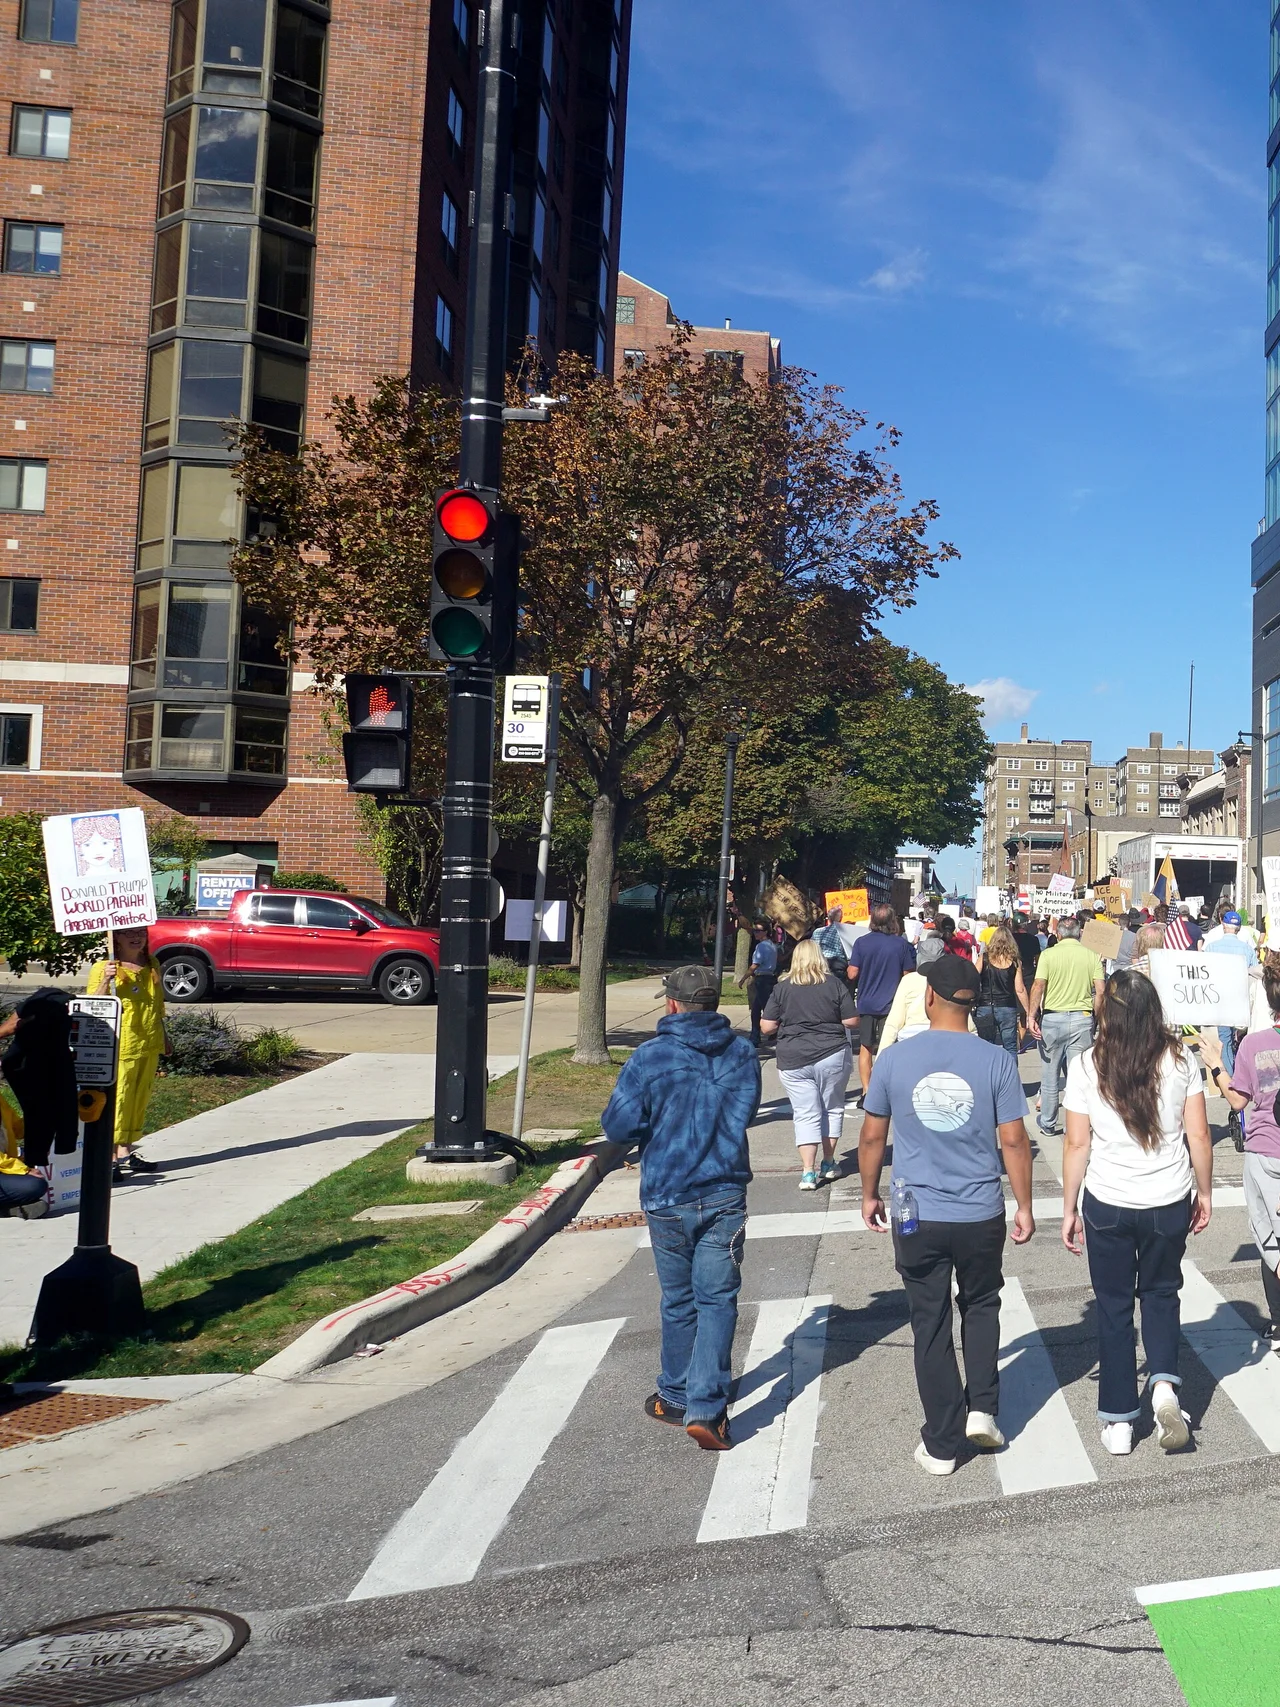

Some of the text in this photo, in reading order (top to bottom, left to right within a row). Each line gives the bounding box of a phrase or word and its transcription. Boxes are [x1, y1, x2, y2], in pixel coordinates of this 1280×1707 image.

[507, 723, 525, 733] 30
[1266, 860, 1280, 871] NO
[201, 877, 250, 888] RENTAL
[61, 879, 148, 901] DONALD TRUMP
[203, 888, 236, 898] OFFI
[1046, 890, 1073, 898] Military
[1095, 886, 1111, 895] ICE
[1043, 897, 1073, 905] American
[1109, 896, 1120, 904] OF
[64, 899, 105, 914] WORLD
[1037, 906, 1068, 914] Streets
[853, 907, 867, 918] CON
[1176, 964, 1210, 980] THIS
[1173, 983, 1221, 1005] SUCKS
[60, 1166, 82, 1178] VERMI
[61, 1190, 81, 1201] EMPE
[35, 1649, 169, 1672] SEWER
